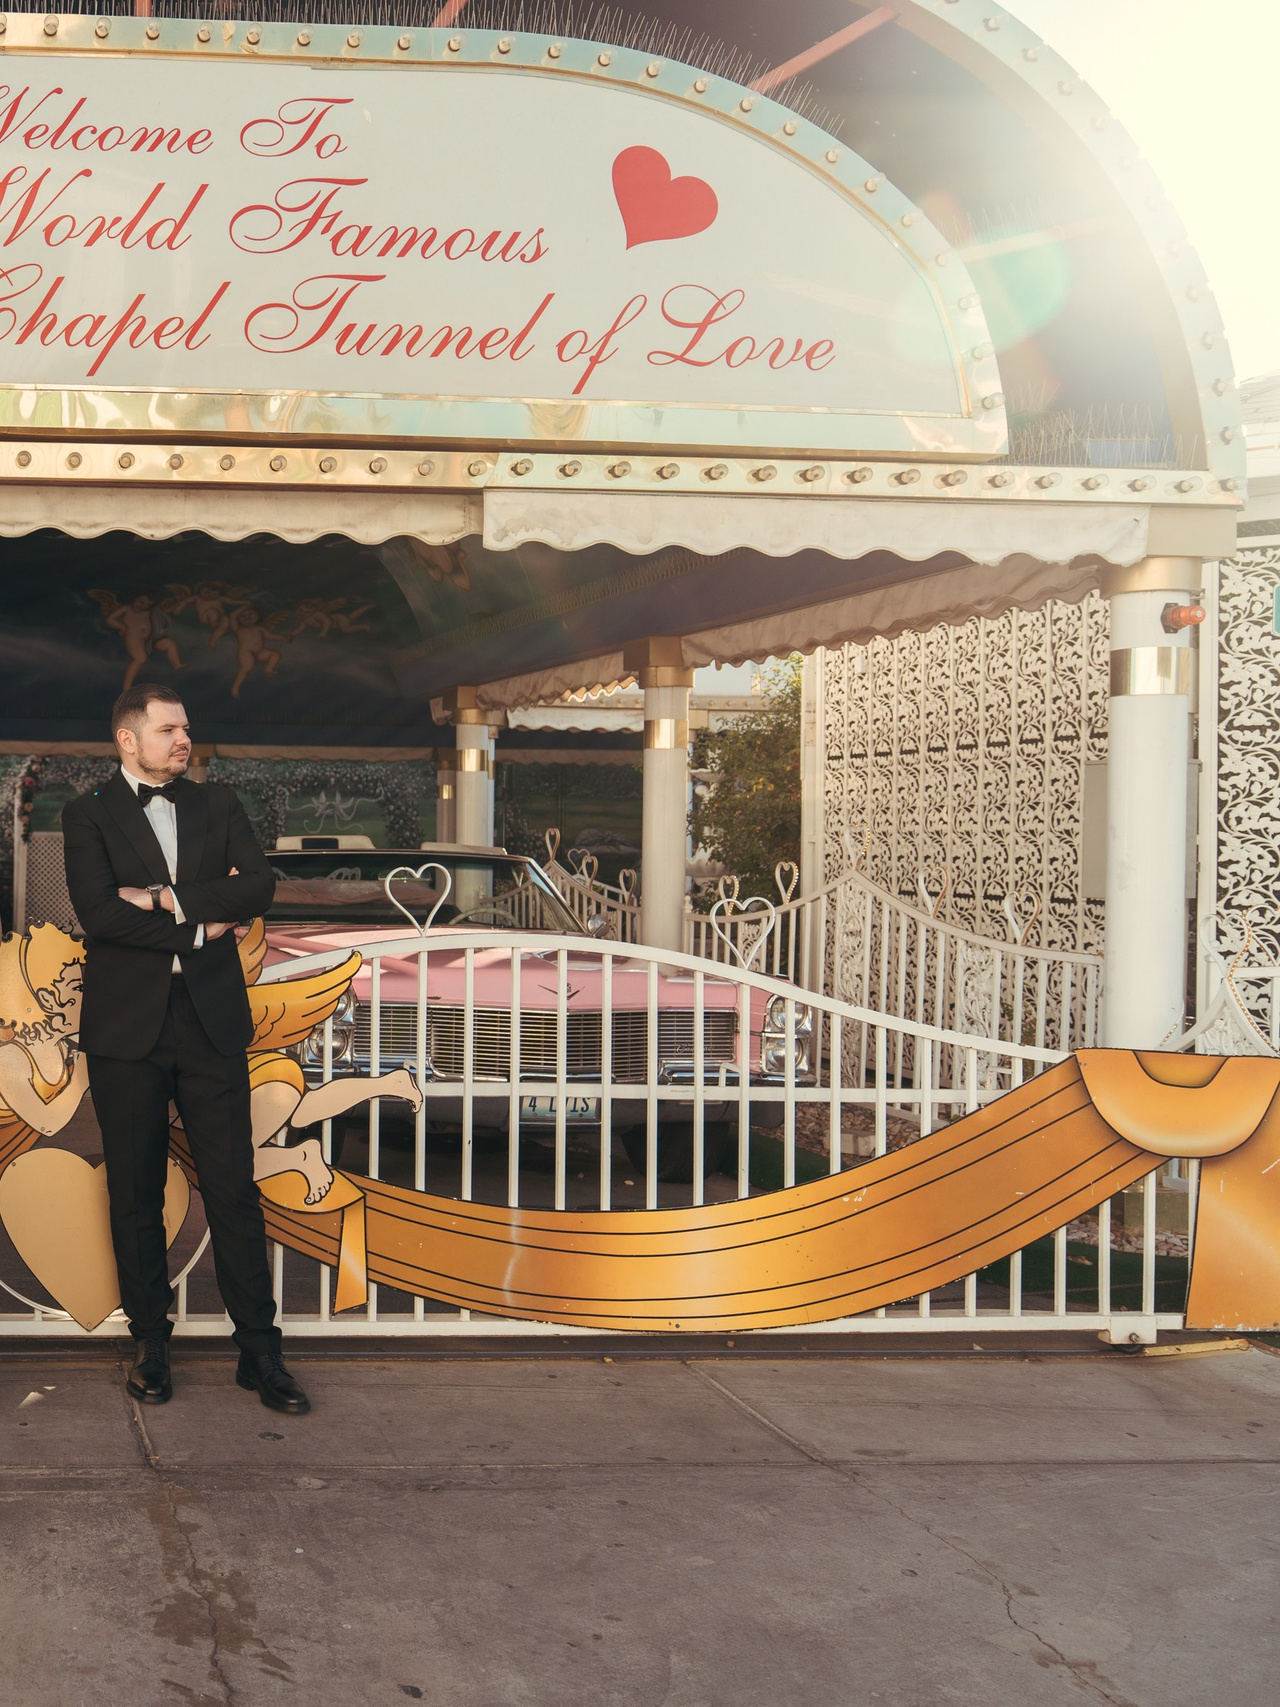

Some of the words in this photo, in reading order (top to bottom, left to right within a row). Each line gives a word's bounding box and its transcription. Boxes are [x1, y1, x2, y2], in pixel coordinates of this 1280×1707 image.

[240, 97, 354, 159] To
[229, 177, 549, 263] Famous
[244, 274, 555, 361] Tunnel
[555, 294, 648, 395] of
[647, 284, 835, 371] Love
